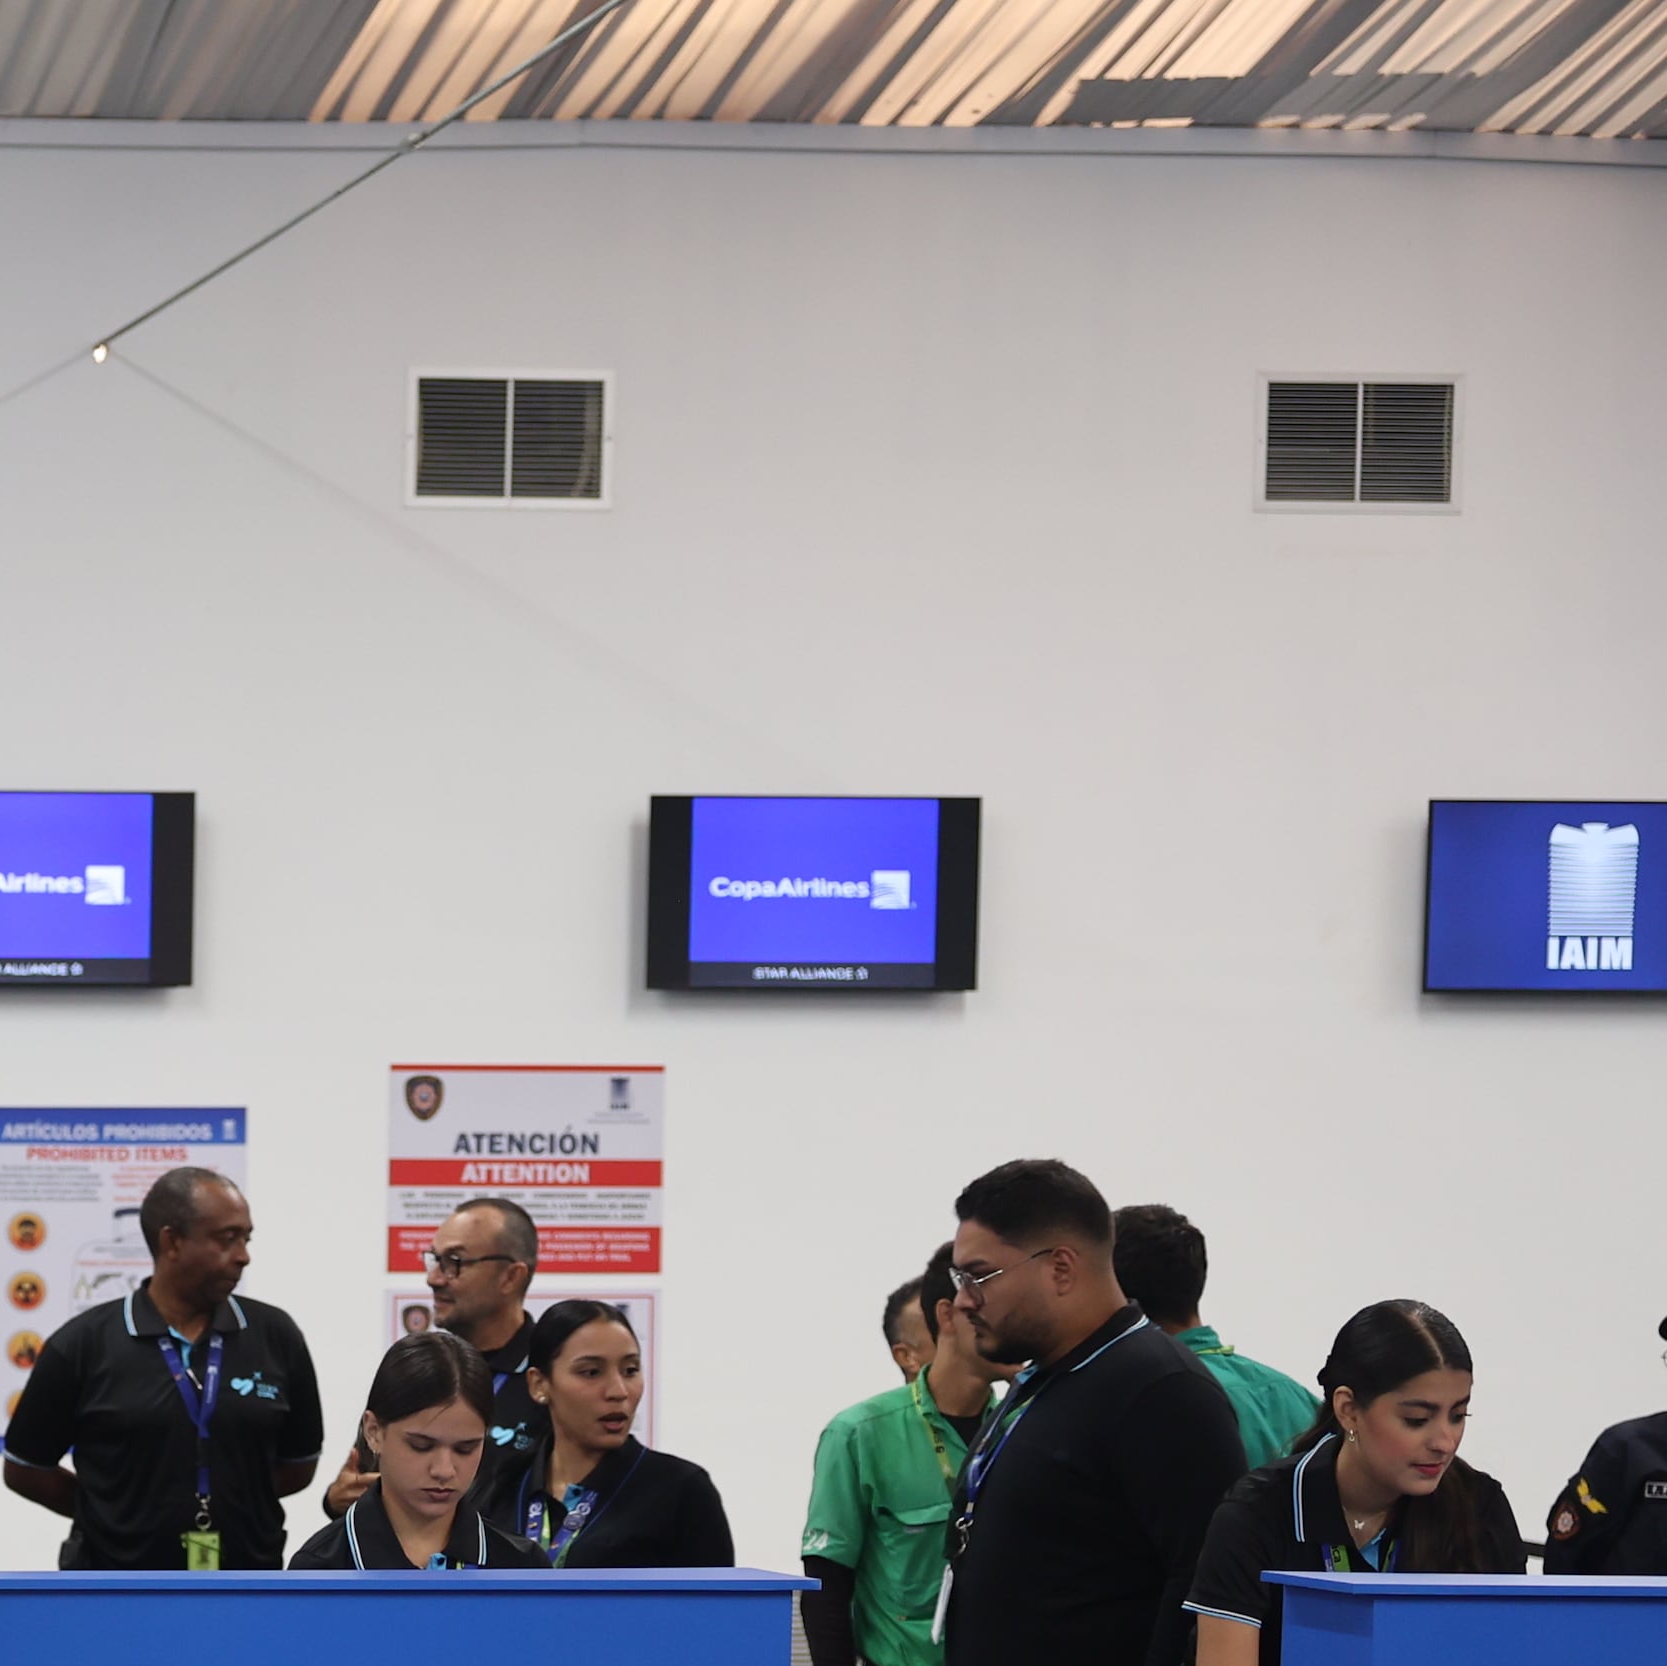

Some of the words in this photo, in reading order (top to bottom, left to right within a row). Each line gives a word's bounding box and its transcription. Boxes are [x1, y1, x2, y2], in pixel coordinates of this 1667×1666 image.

[709, 876, 871, 901] CopaAirlines
[1547, 936, 1633, 970] IAIM
[2, 1119, 98, 1140] ARTÍCULOS
[103, 1123, 213, 1141] PROHIBIDOS
[454, 1124, 599, 1155] ATENCIÓN
[27, 1146, 130, 1162] PROHIBITED
[136, 1146, 188, 1162] ITEMS
[461, 1163, 590, 1184] ATTENTION
